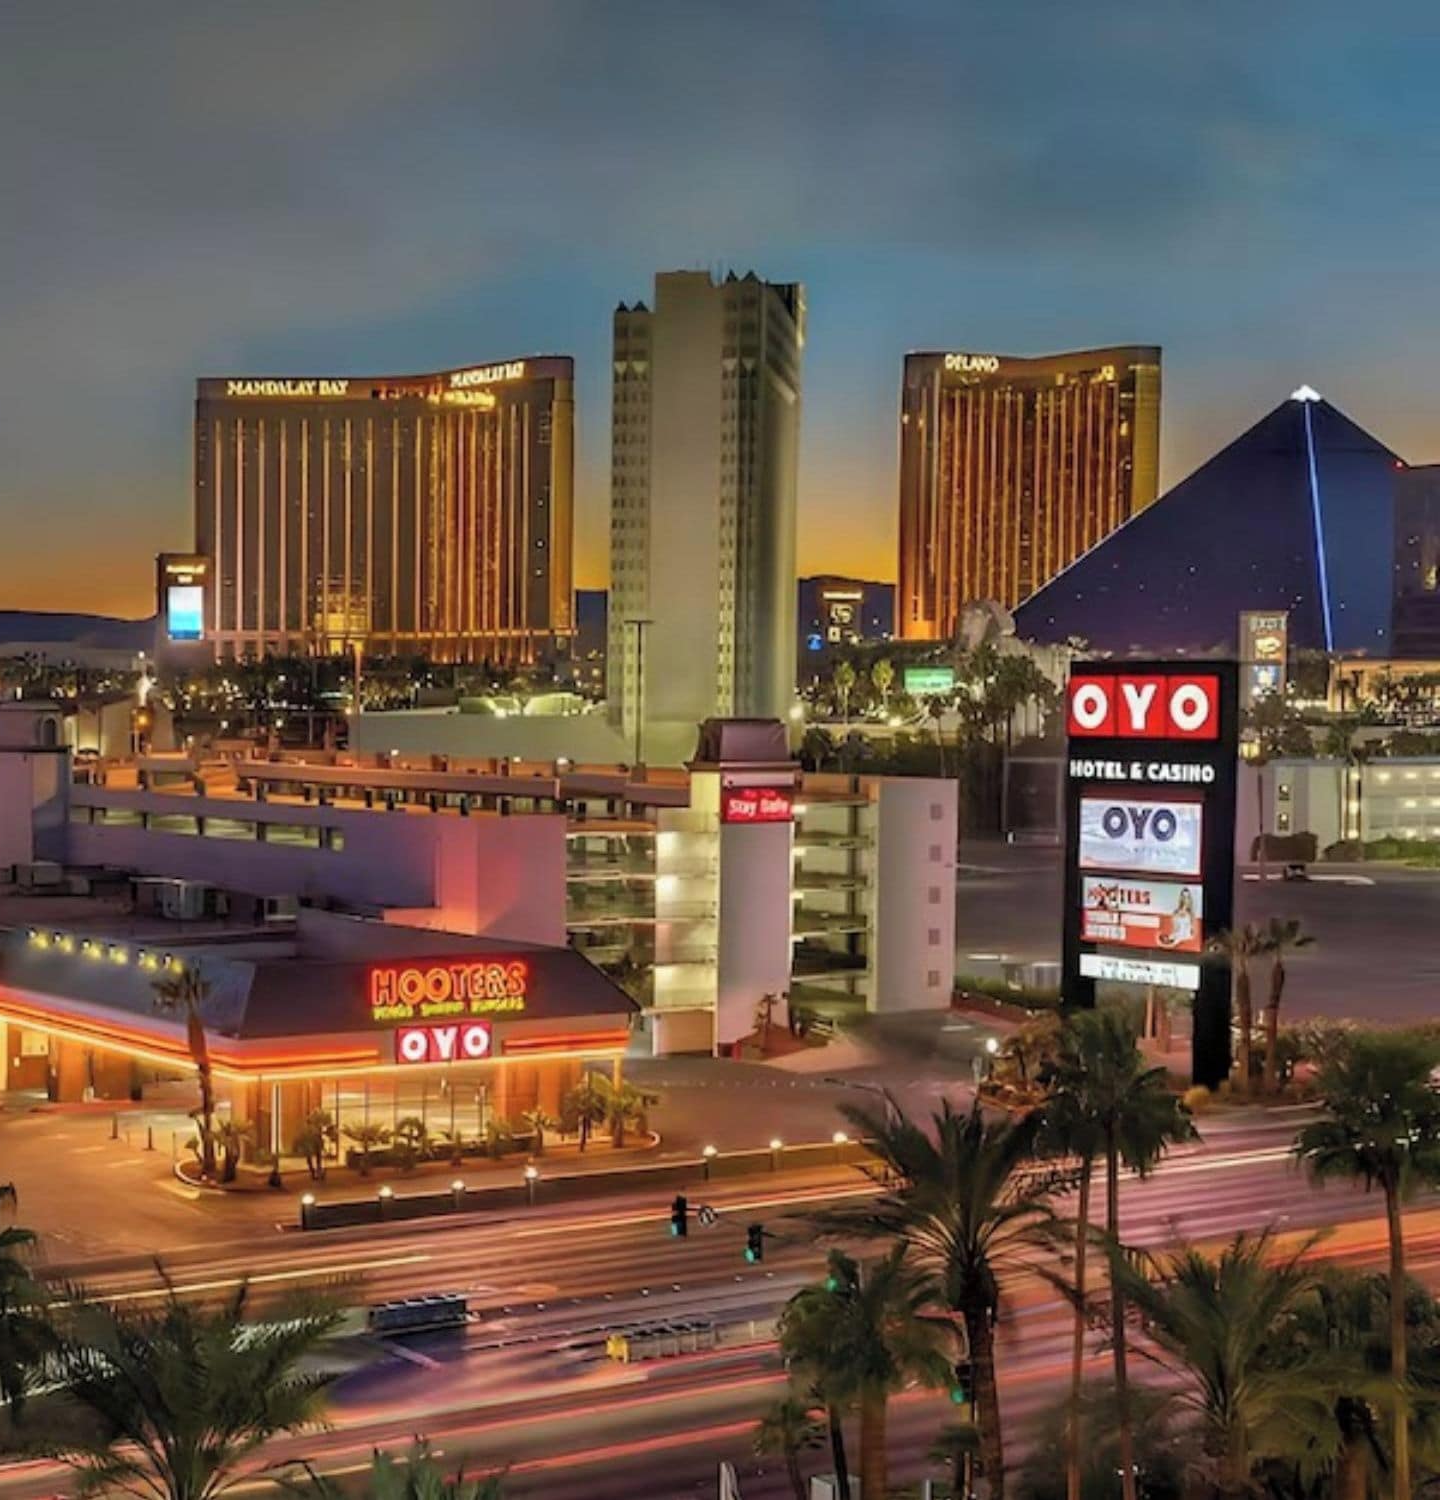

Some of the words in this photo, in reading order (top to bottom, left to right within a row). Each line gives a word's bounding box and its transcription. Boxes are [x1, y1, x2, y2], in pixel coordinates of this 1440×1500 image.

[226, 380, 316, 396] MANDALAY
[1072, 683, 1210, 731] OYO
[1069, 759, 1126, 780] HOTEL
[1129, 761, 1143, 780] &
[1147, 763, 1215, 783] CASINO
[728, 799, 757, 817] Stay
[1102, 806, 1177, 842] OYO
[371, 962, 527, 1006] HOOTERS
[401, 1026, 489, 1061] OYO
